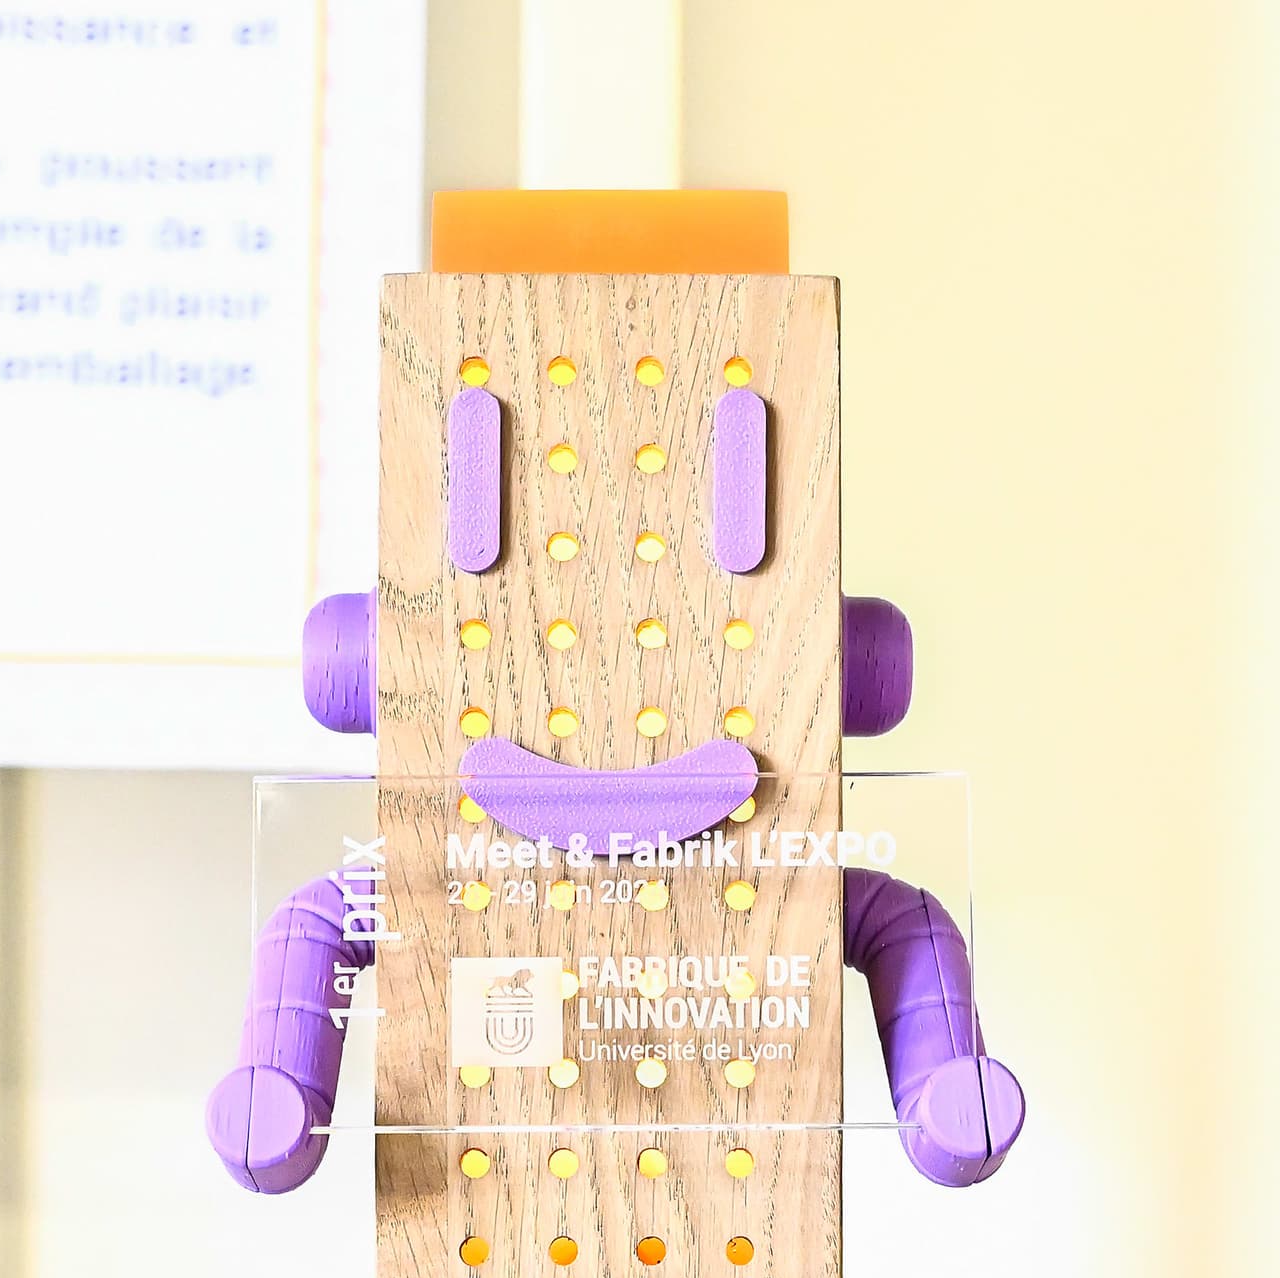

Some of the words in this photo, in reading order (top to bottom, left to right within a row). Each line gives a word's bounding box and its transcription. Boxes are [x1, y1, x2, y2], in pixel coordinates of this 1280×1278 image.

[447, 832, 554, 869] Meet
[565, 832, 596, 869] &
[608, 831, 738, 869] Fabrik
[751, 830, 897, 868] L'EXPO
[329, 834, 402, 942] prix
[502, 880, 535, 904] 29
[770, 955, 811, 987] DE
[329, 961, 387, 1030] 1er
[579, 996, 810, 1030] L'INNOVATION
[578, 1038, 696, 1063] Université
[701, 1038, 731, 1062] de
[739, 1039, 793, 1066] Lyon
